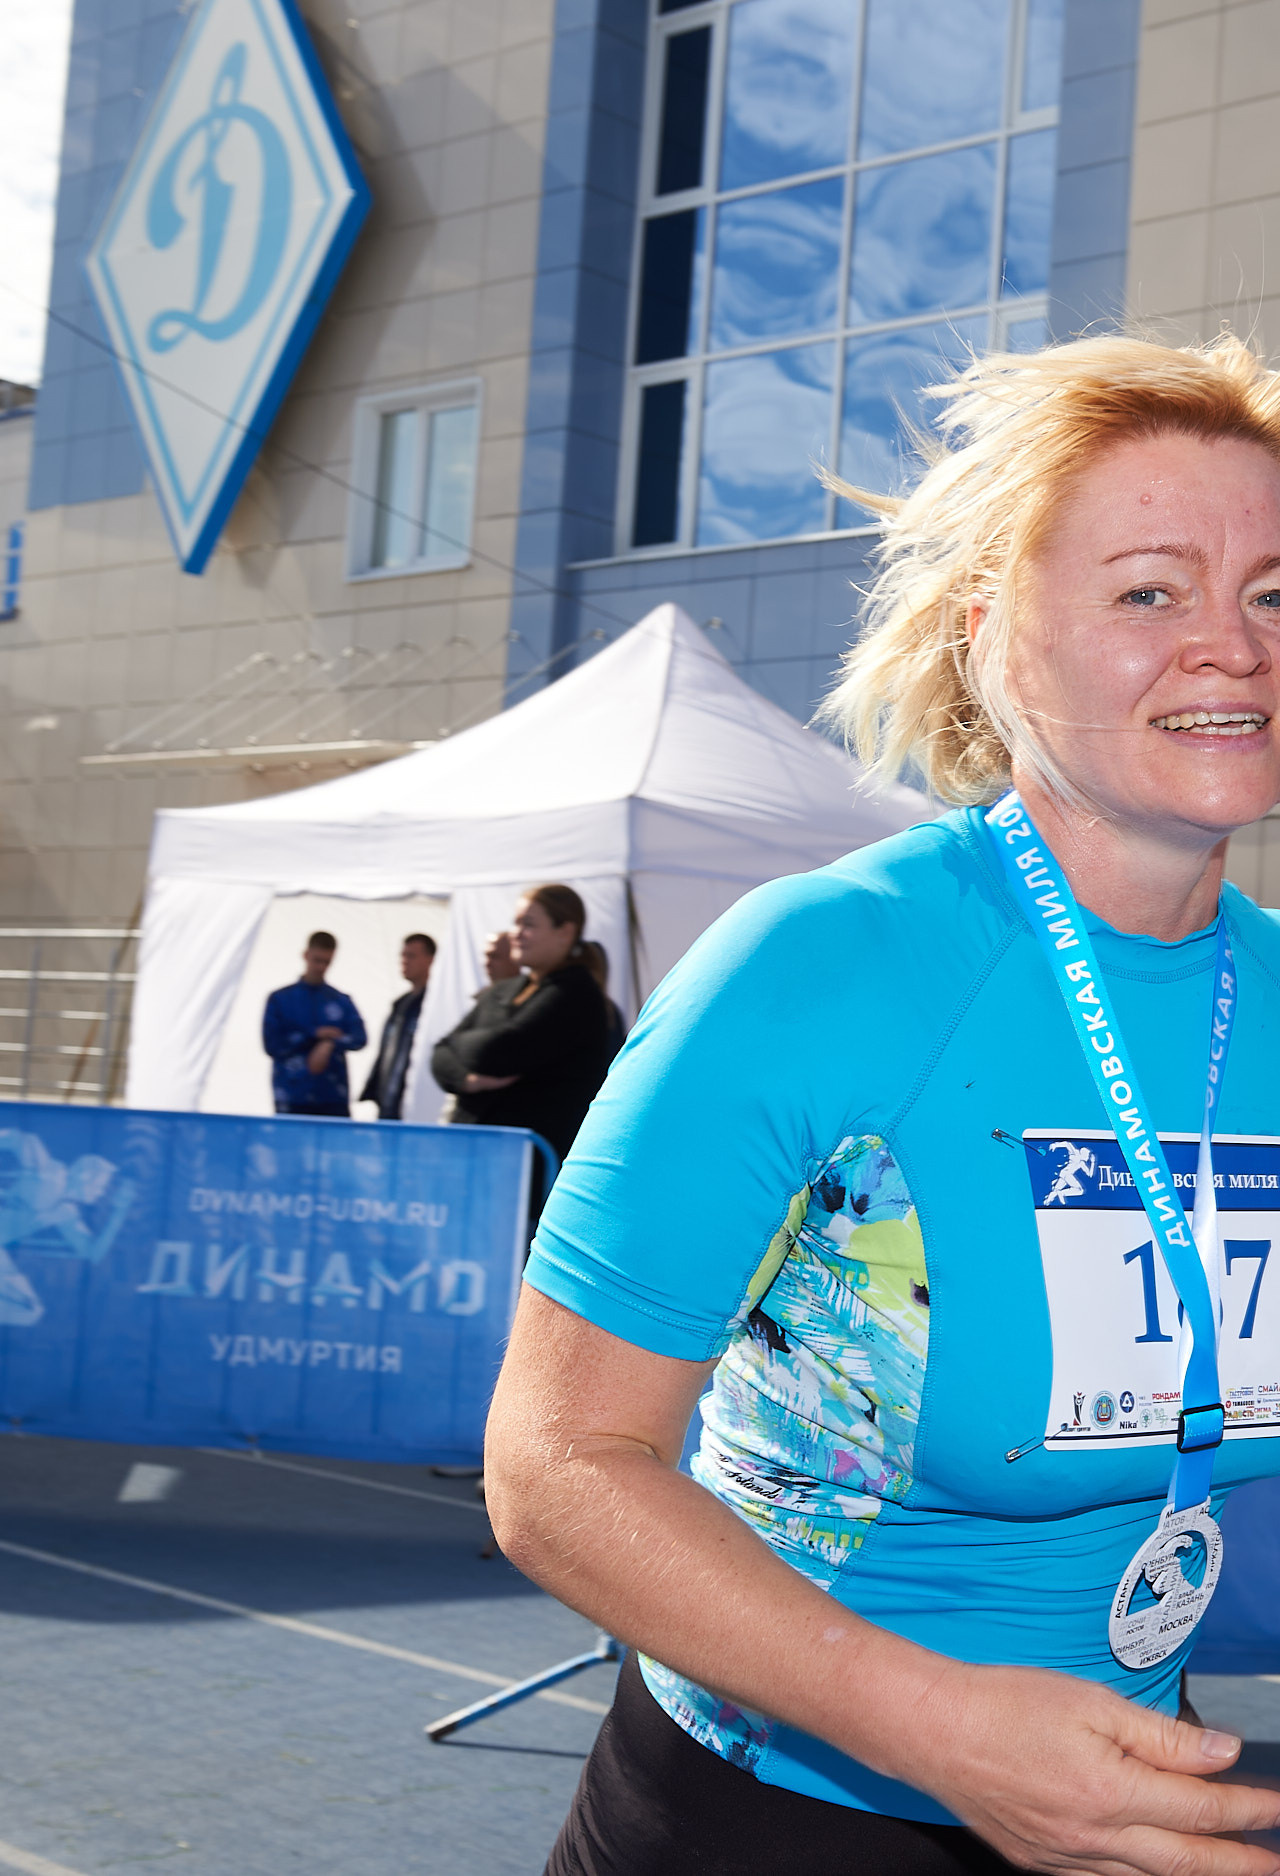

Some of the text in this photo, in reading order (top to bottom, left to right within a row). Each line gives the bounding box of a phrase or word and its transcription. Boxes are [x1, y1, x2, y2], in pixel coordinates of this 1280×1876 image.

[1015, 846, 1080, 951] МИЛЯ
[1065, 959, 1191, 1247] ДИНАМОВСКАЯ
[1098, 1165, 1280, 1191] Динвся миля
[136, 1241, 487, 1316] ДИНАМО
[1123, 1239, 1272, 1343] 17
[209, 1334, 403, 1373] УДМУРТИЯ
[1158, 1614, 1194, 1635] МОСКВА
